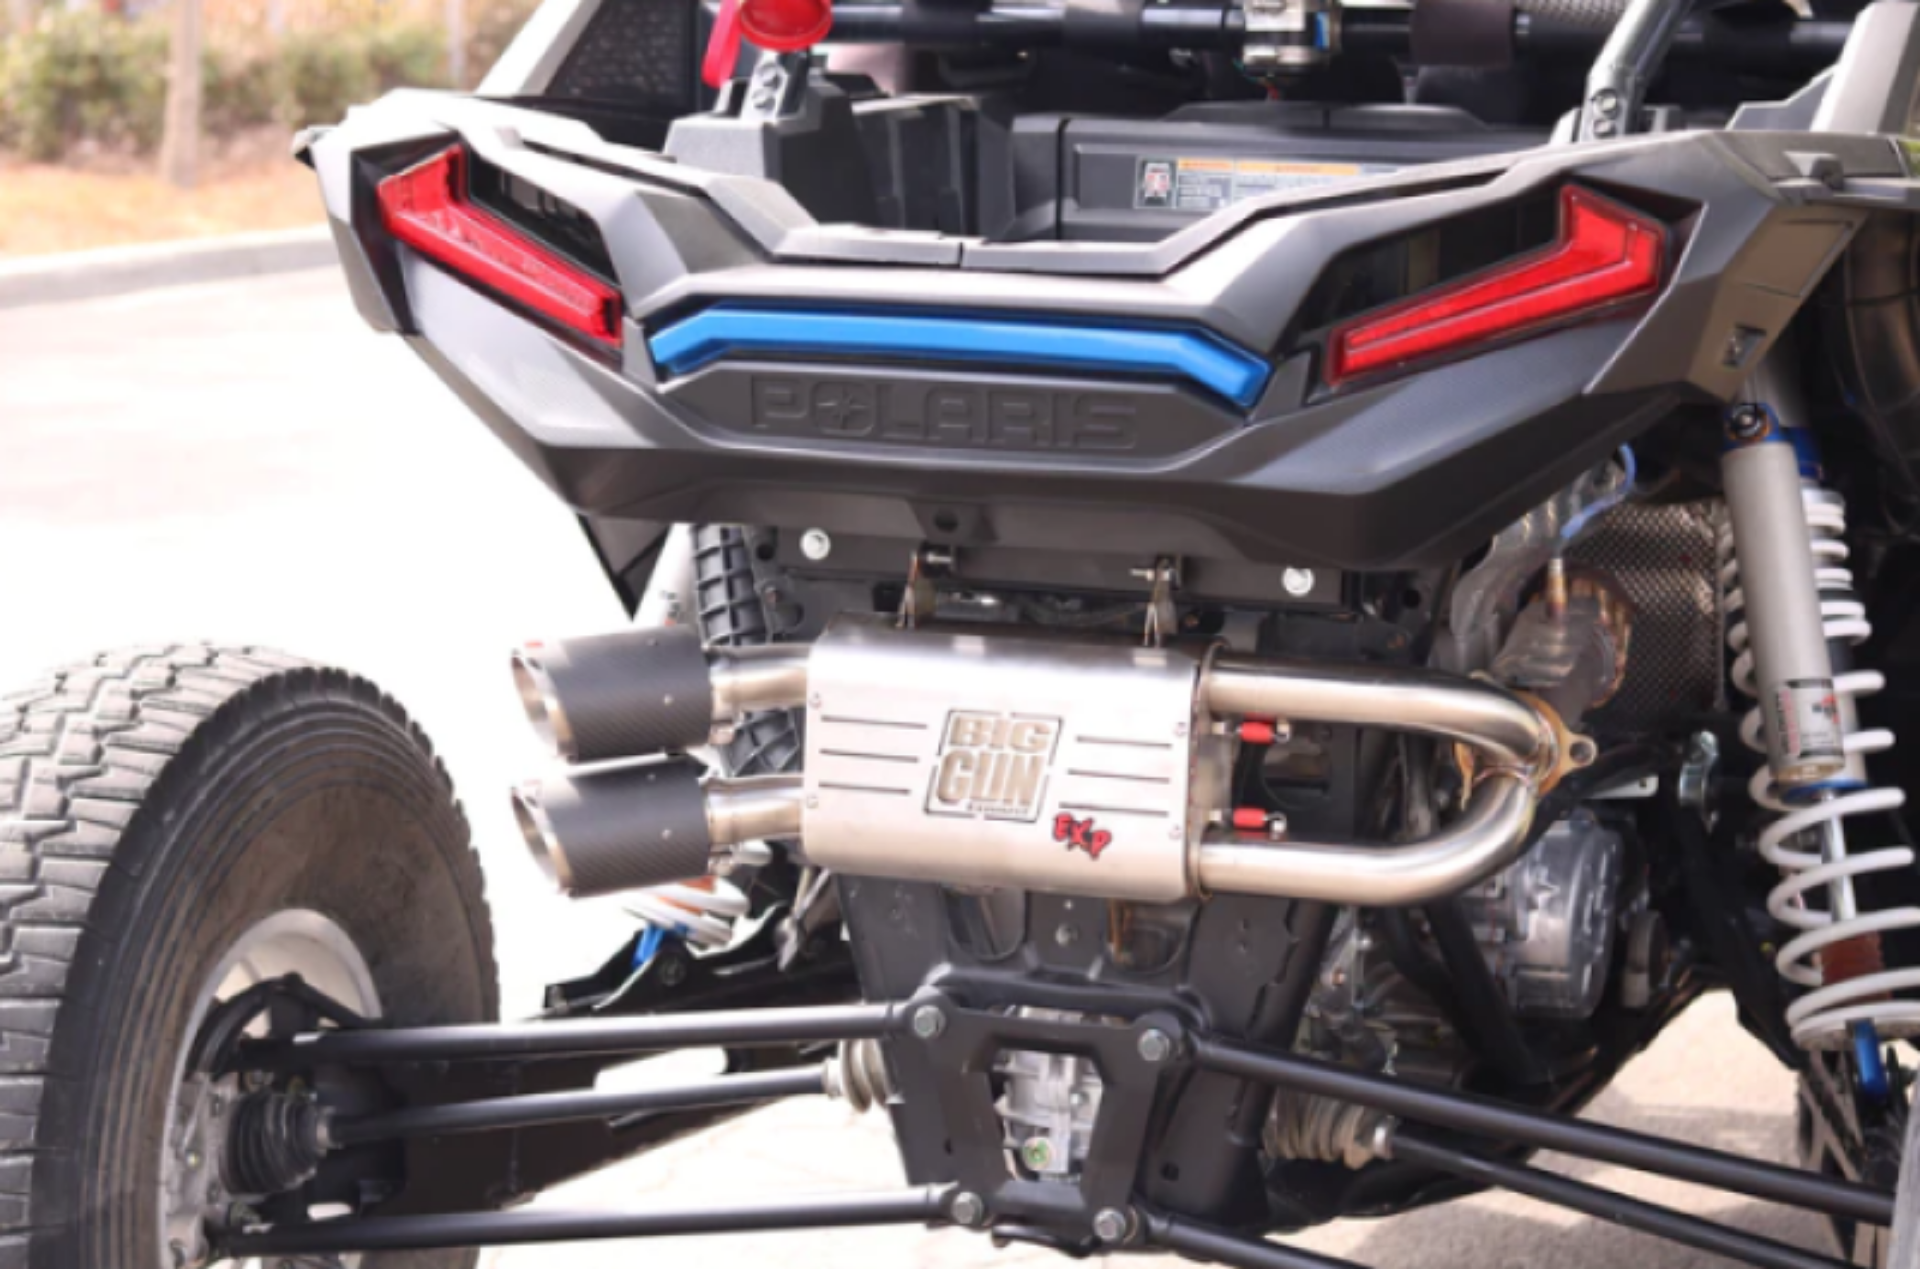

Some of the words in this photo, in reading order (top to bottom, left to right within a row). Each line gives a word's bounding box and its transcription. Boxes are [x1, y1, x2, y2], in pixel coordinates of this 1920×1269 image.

[750, 375, 1136, 449] POLARIS
[949, 716, 1051, 753] BIG
[936, 750, 1044, 807] GUN
